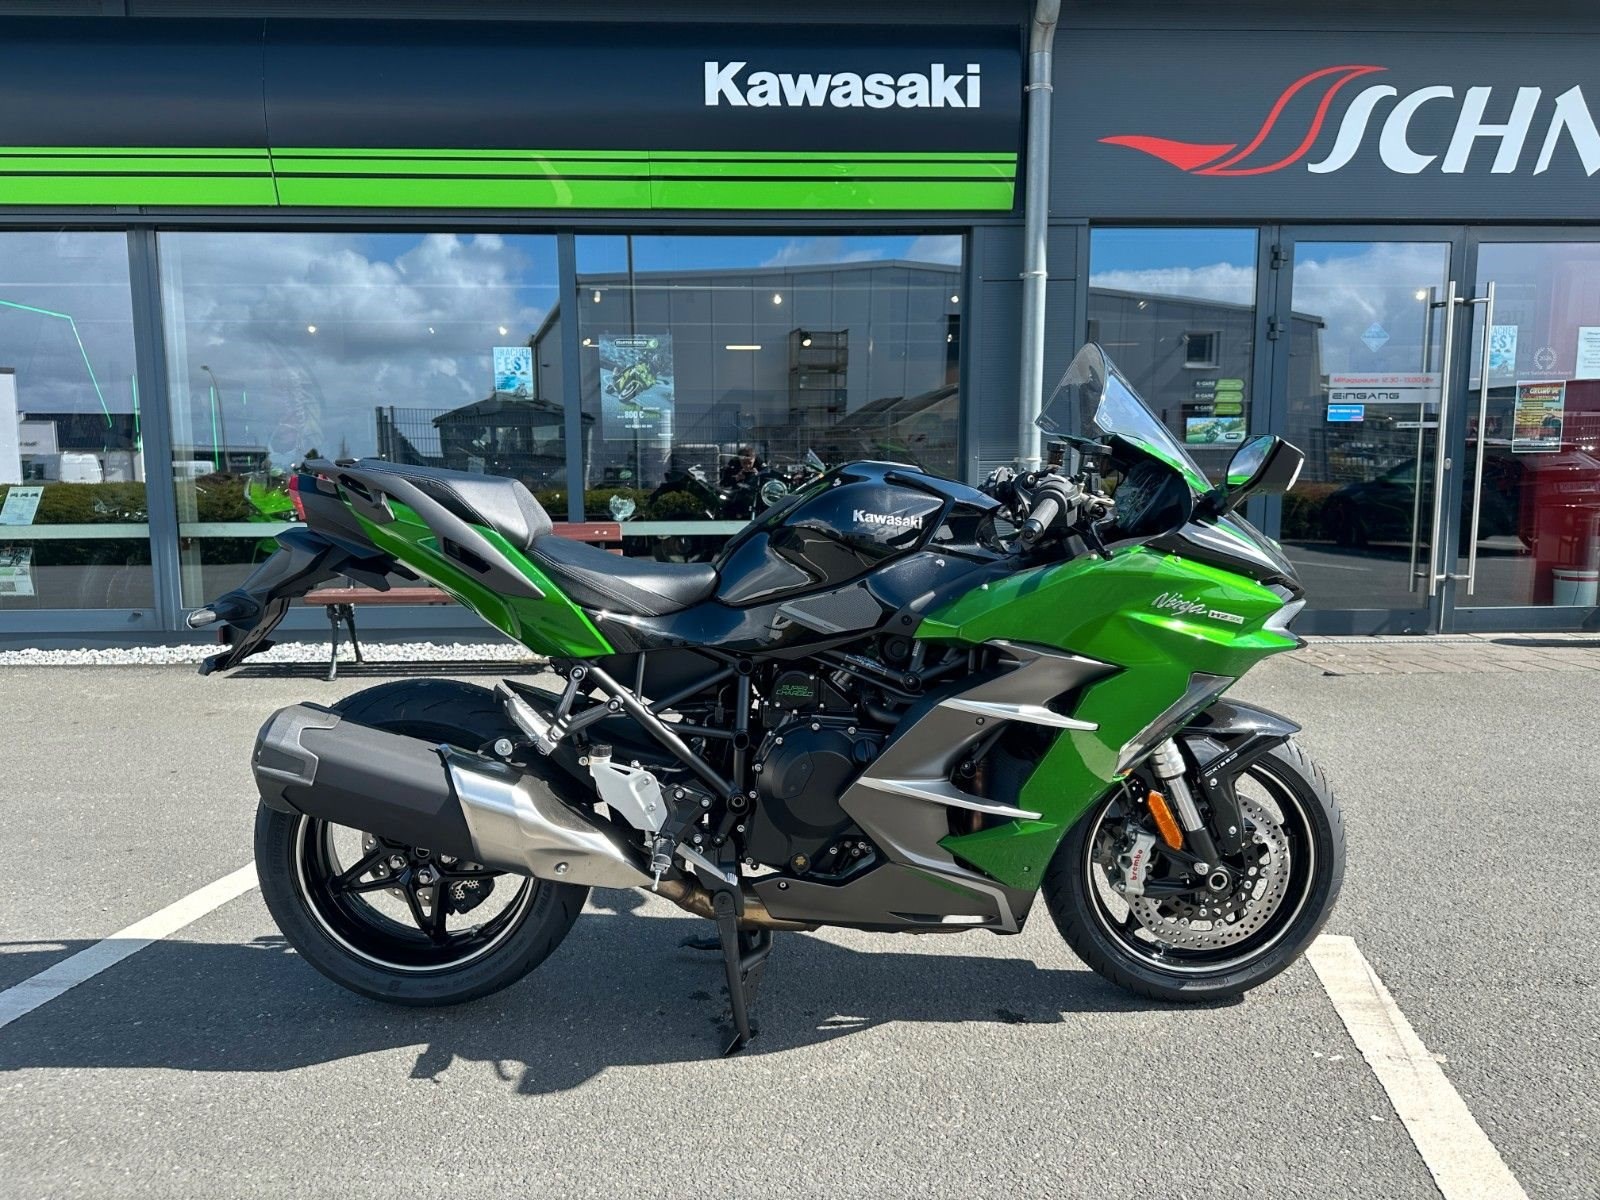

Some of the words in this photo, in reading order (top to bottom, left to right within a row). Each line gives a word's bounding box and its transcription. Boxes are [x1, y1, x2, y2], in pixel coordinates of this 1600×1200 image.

[705, 61, 980, 108] Kawasaki
[852, 509, 923, 530] Kawasaki
[1151, 592, 1207, 616] Ninja
[1130, 849, 1143, 881] brembo
